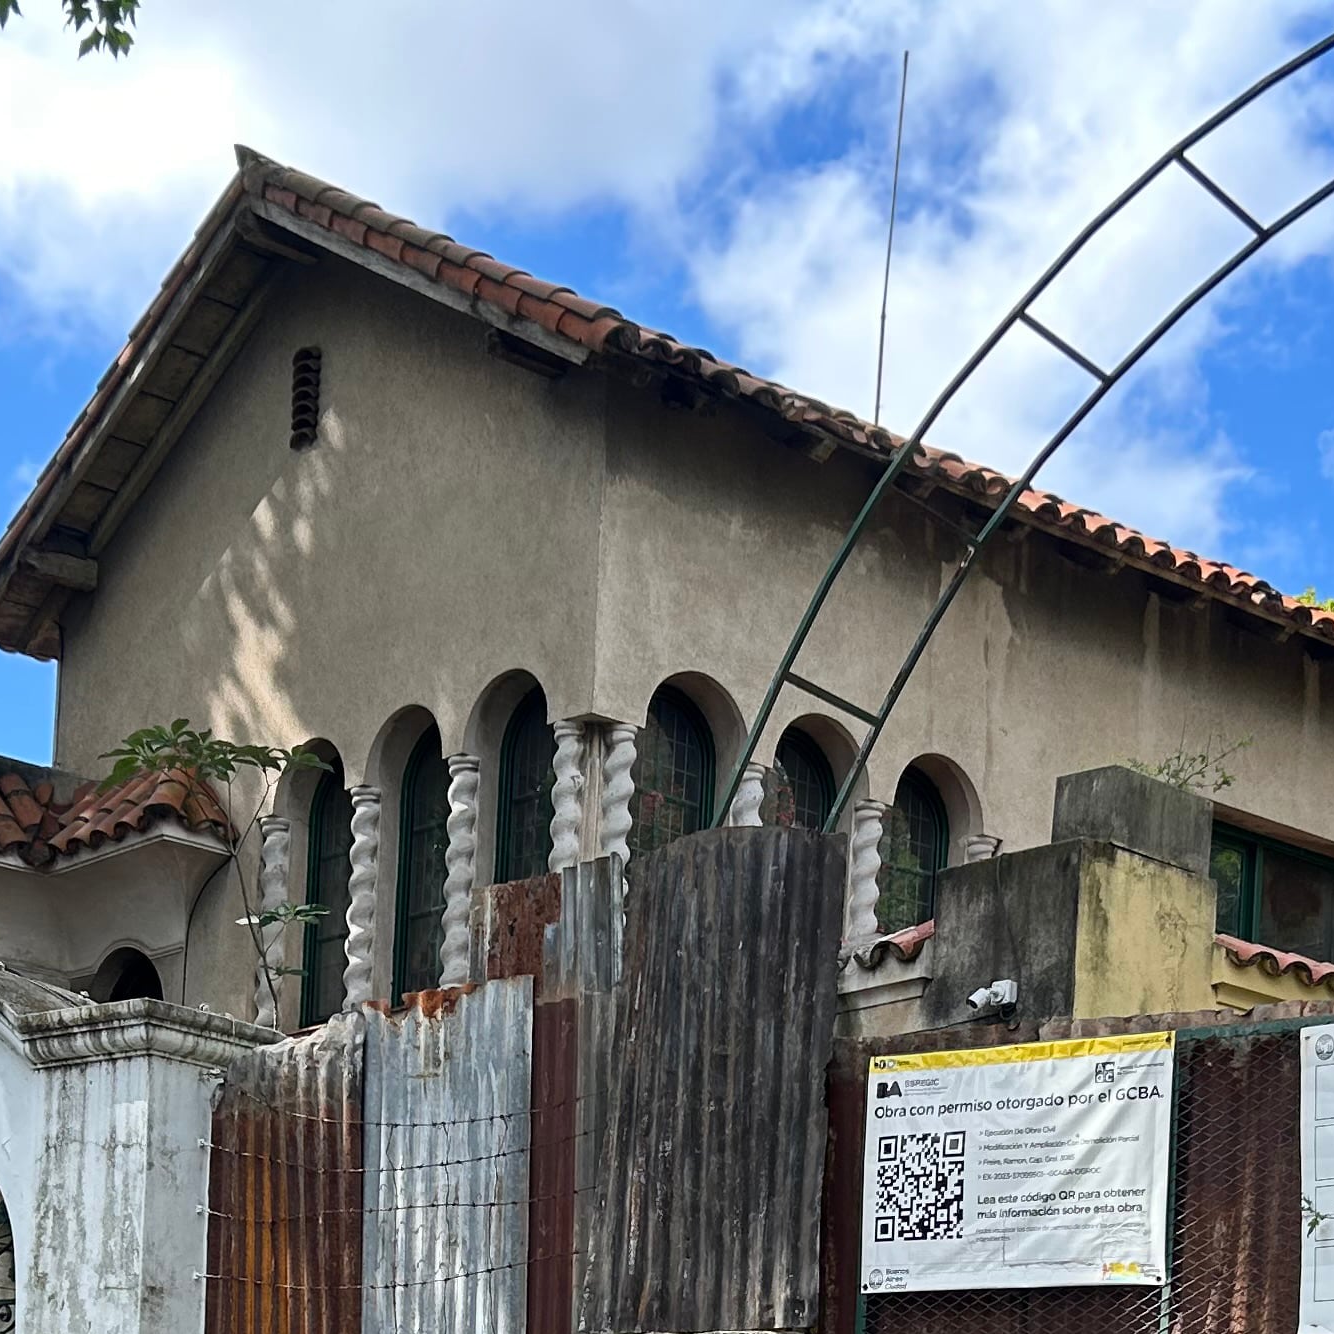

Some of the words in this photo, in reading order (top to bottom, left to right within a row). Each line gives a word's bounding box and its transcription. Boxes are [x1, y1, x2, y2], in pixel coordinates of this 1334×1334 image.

[874, 1104, 907, 1119] Obra
[909, 1105, 934, 1117] con
[938, 1099, 992, 1117] permiso
[996, 1092, 1064, 1111] otorgado
[1068, 1093, 1094, 1108] por
[1098, 1089, 1111, 1103] el
[1116, 1085, 1165, 1101] GCBA.
[977, 1194, 996, 1205] Lea
[998, 1193, 1019, 1204] este
[1020, 1191, 1057, 1203] código
[1059, 1190, 1075, 1200] QR
[1078, 1190, 1101, 1201] para
[1103, 1187, 1146, 1198] obtener
[977, 1208, 997, 1219] más
[999, 1205, 1060, 1218] información
[1062, 1204, 1091, 1215] sobre
[1093, 1203, 1115, 1214] esta
